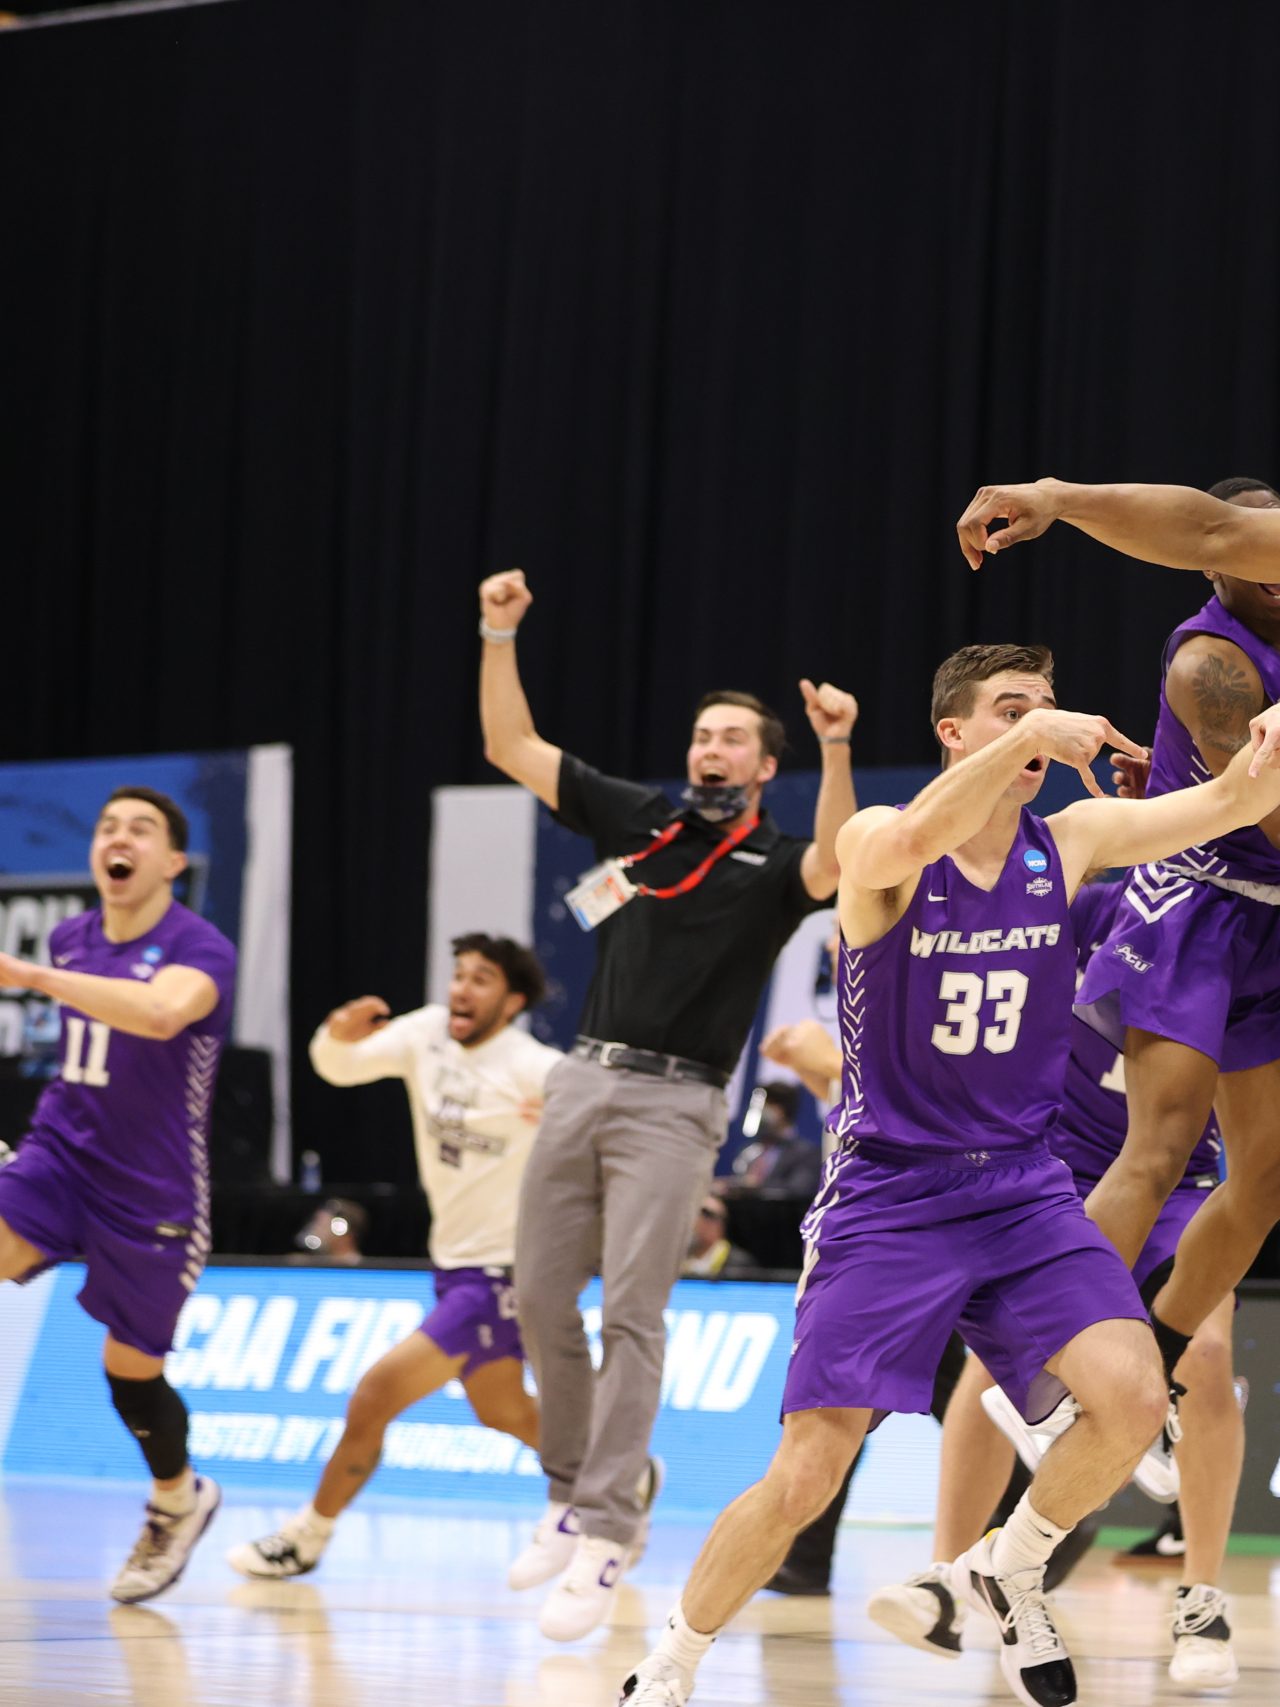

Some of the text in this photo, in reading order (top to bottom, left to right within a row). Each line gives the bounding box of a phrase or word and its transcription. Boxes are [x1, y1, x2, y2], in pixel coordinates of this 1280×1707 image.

[910, 923, 1061, 959] WILDCATS
[1113, 943, 1154, 974] ACU
[931, 969, 1029, 1055] 33
[62, 1015, 111, 1087] 11
[163, 1294, 299, 1391] CAA
